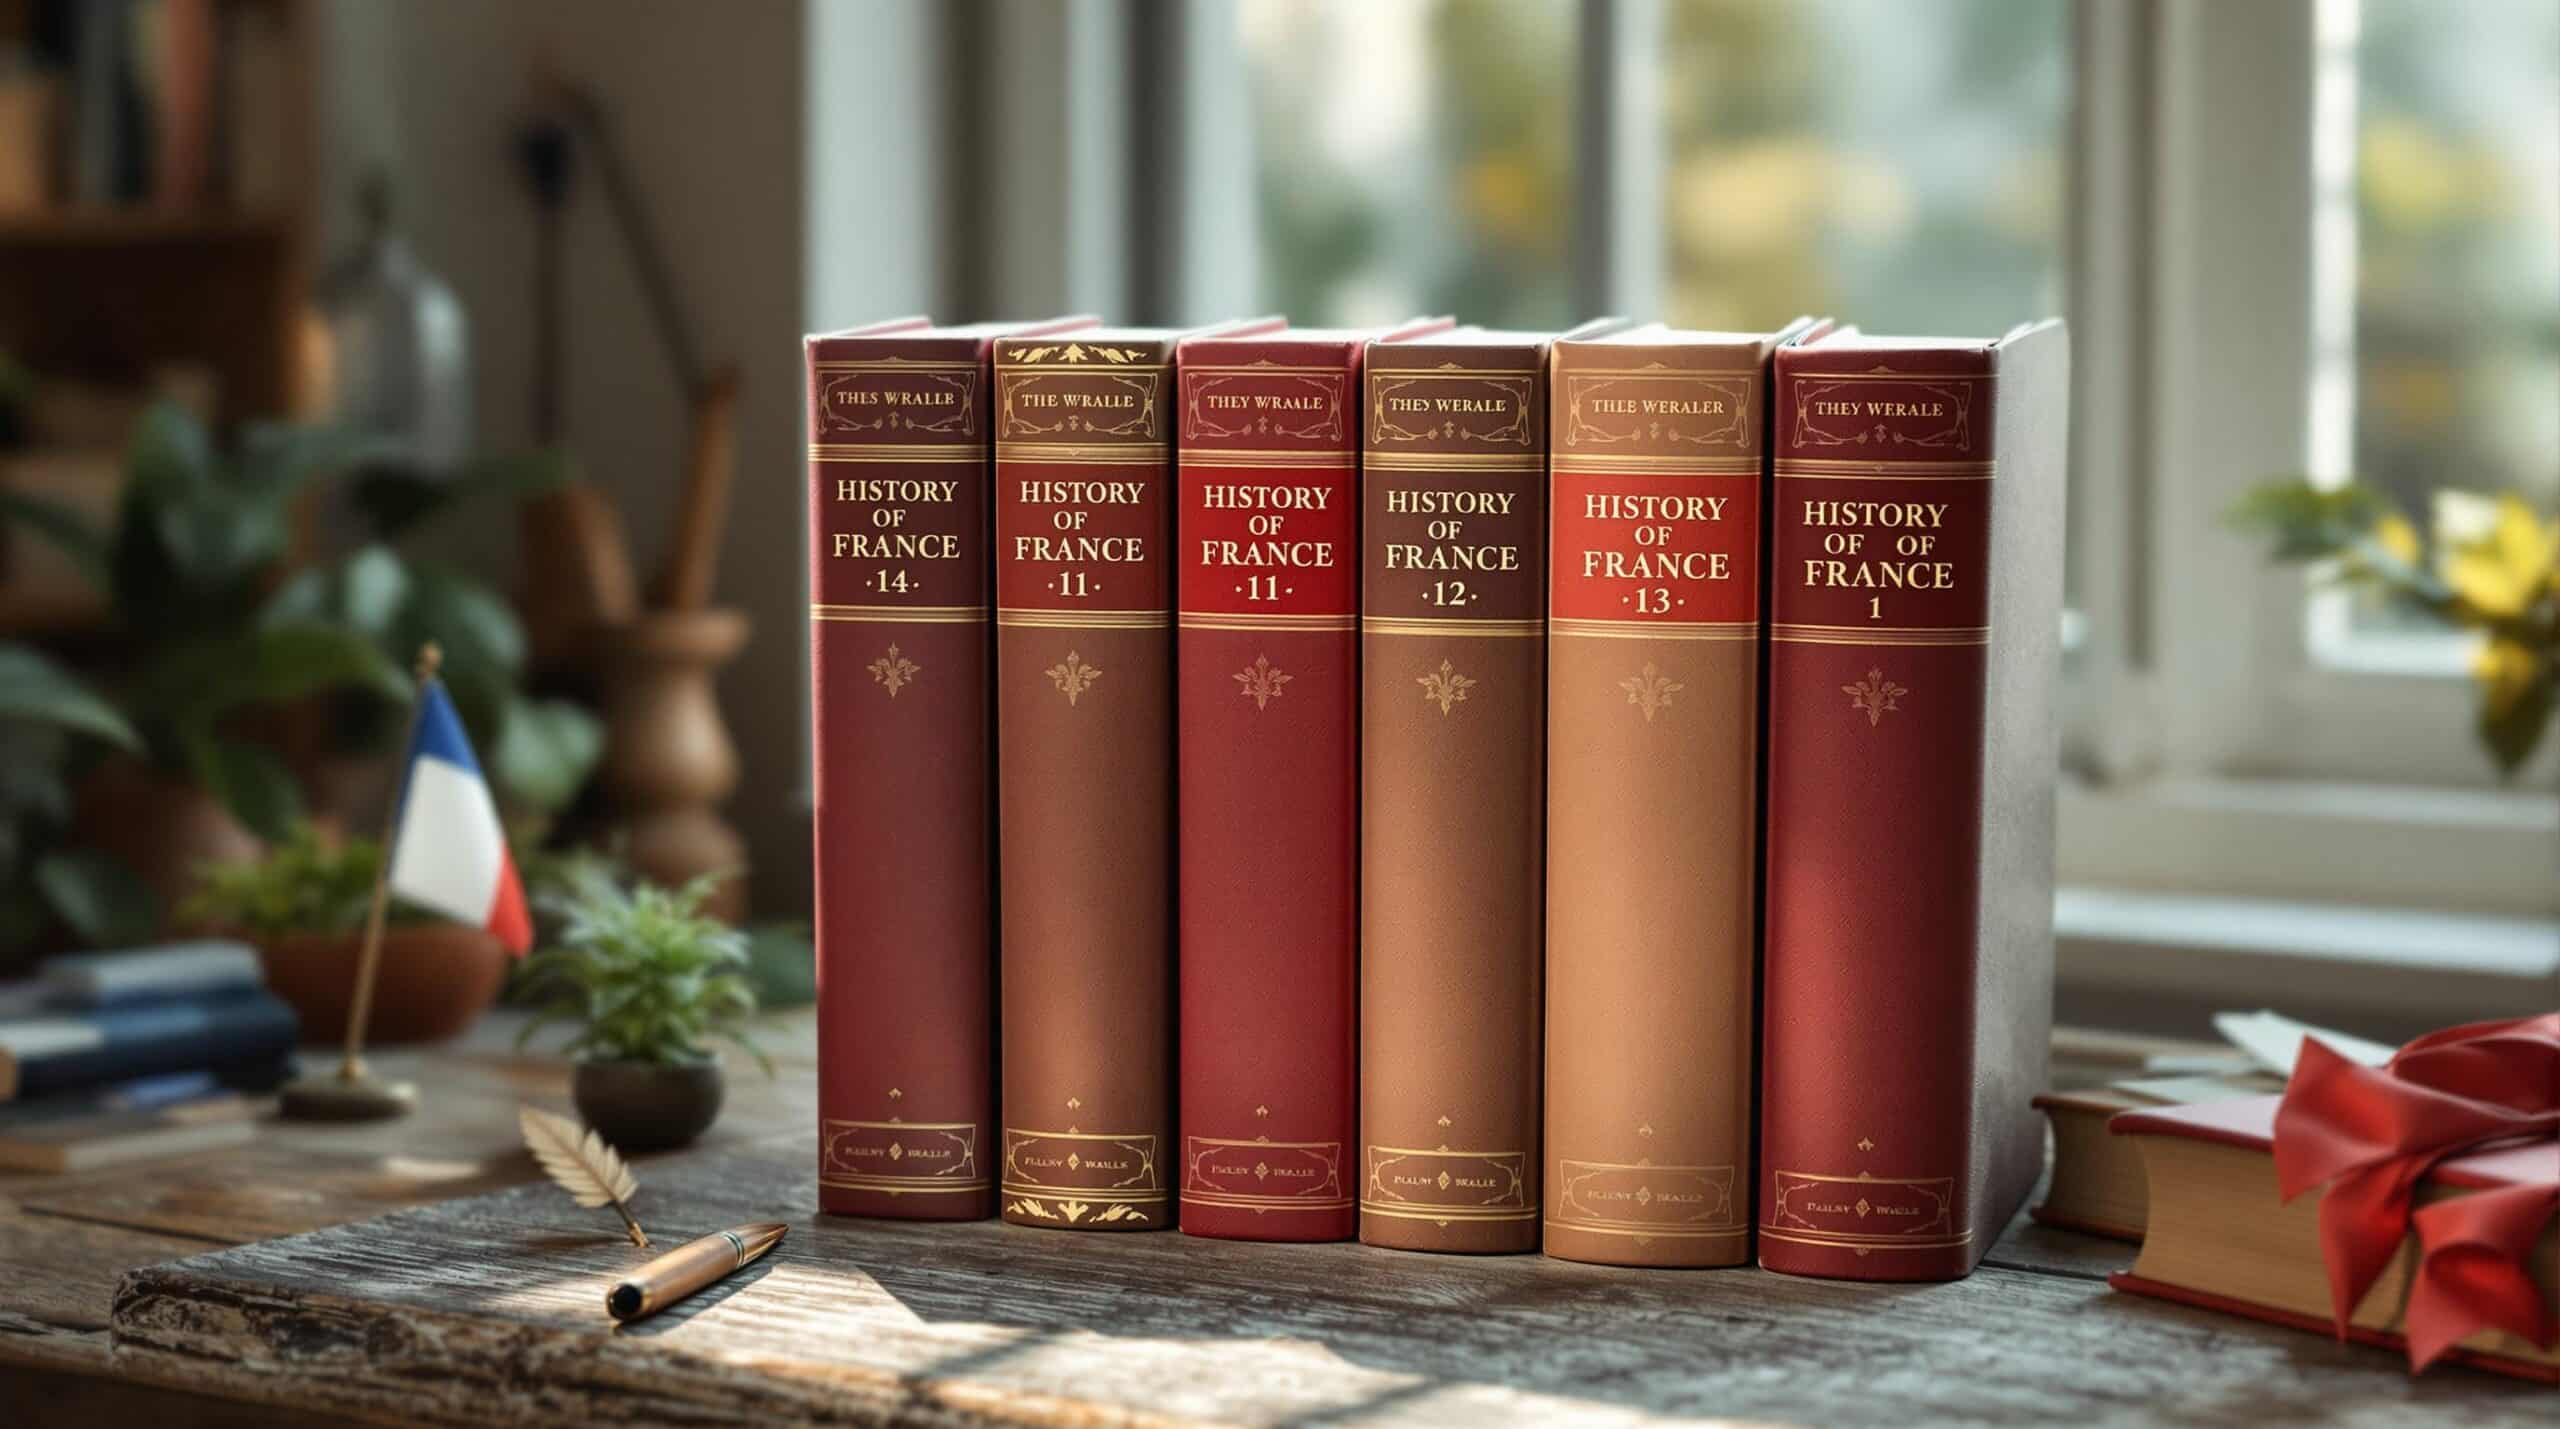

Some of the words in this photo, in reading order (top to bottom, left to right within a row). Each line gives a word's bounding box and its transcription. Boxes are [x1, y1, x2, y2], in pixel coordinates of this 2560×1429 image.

[1207, 395, 1250, 409] THEY
[1389, 398, 1430, 412] THEY
[1815, 401, 1861, 416] THEY
[838, 479, 958, 502] HISTORY
[1020, 481, 1145, 504] HISTORY
[1204, 485, 1332, 510] HISTORY
[1387, 490, 1515, 514] HISTORY
[872, 508, 906, 527] OF
[1584, 494, 1728, 521] HISTORY
[1803, 500, 1947, 527] HISTORY
[1053, 511, 1088, 530] OF
[1248, 515, 1284, 536] OF
[1427, 520, 1463, 540] OF
[833, 533, 960, 559] FRANCE
[1634, 525, 1673, 546] OF
[1824, 533, 1865, 555] OF
[1896, 535, 1935, 556] OF
[1015, 536, 1144, 562] FRANCE
[1202, 540, 1334, 567] FRANCE
[1386, 544, 1519, 571] FRANCE
[1583, 551, 1730, 580] FRANCE
[1804, 559, 1954, 589] FRANCE
[1870, 597, 1881, 619] 1
